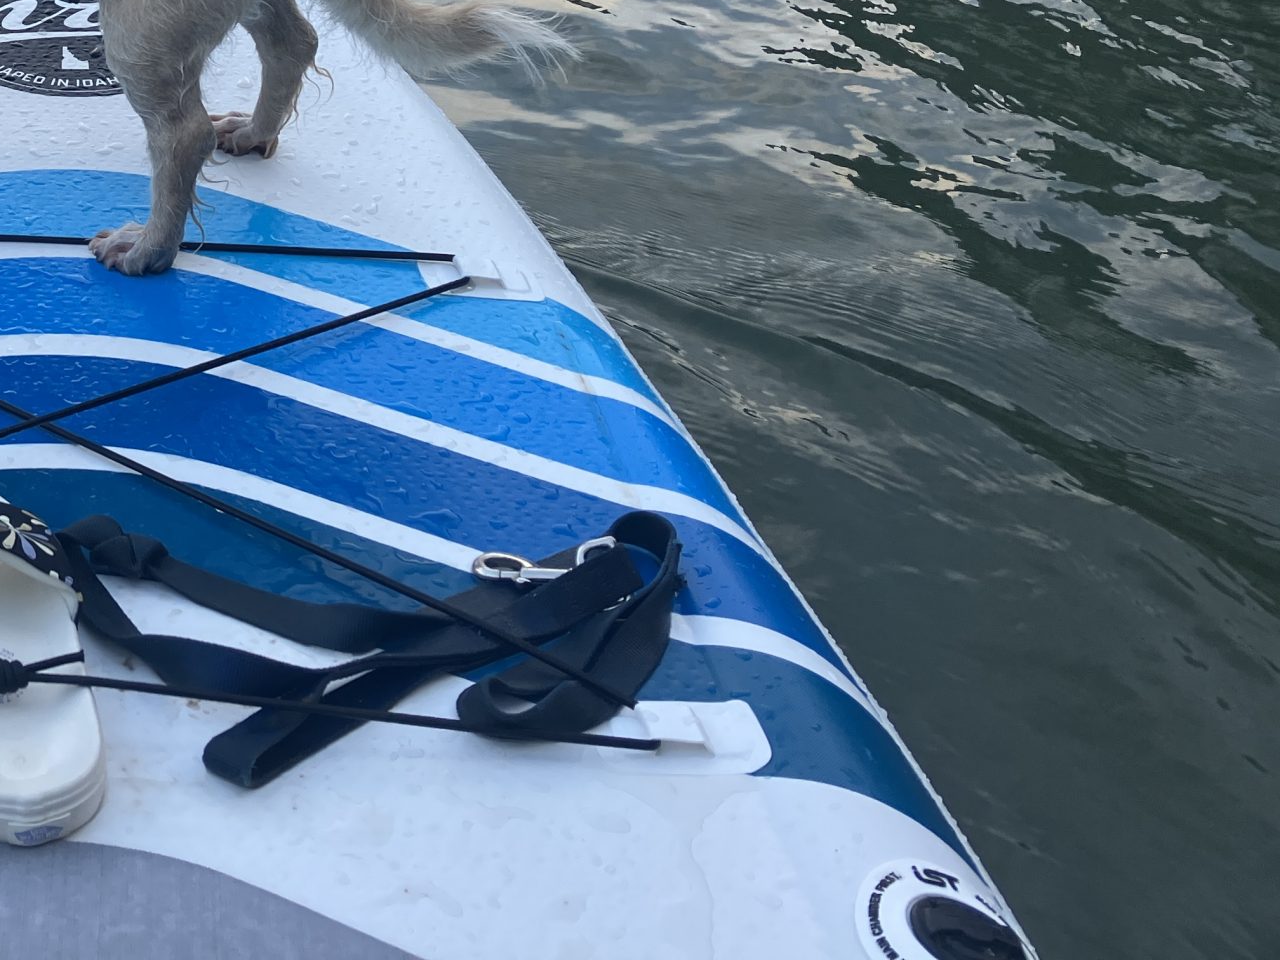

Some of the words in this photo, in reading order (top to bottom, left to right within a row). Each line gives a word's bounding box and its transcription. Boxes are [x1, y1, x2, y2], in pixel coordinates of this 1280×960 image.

[50, 77, 71, 87] IN
[76, 77, 120, 87] IDAH
[867, 892, 884, 937] CHAMBER
